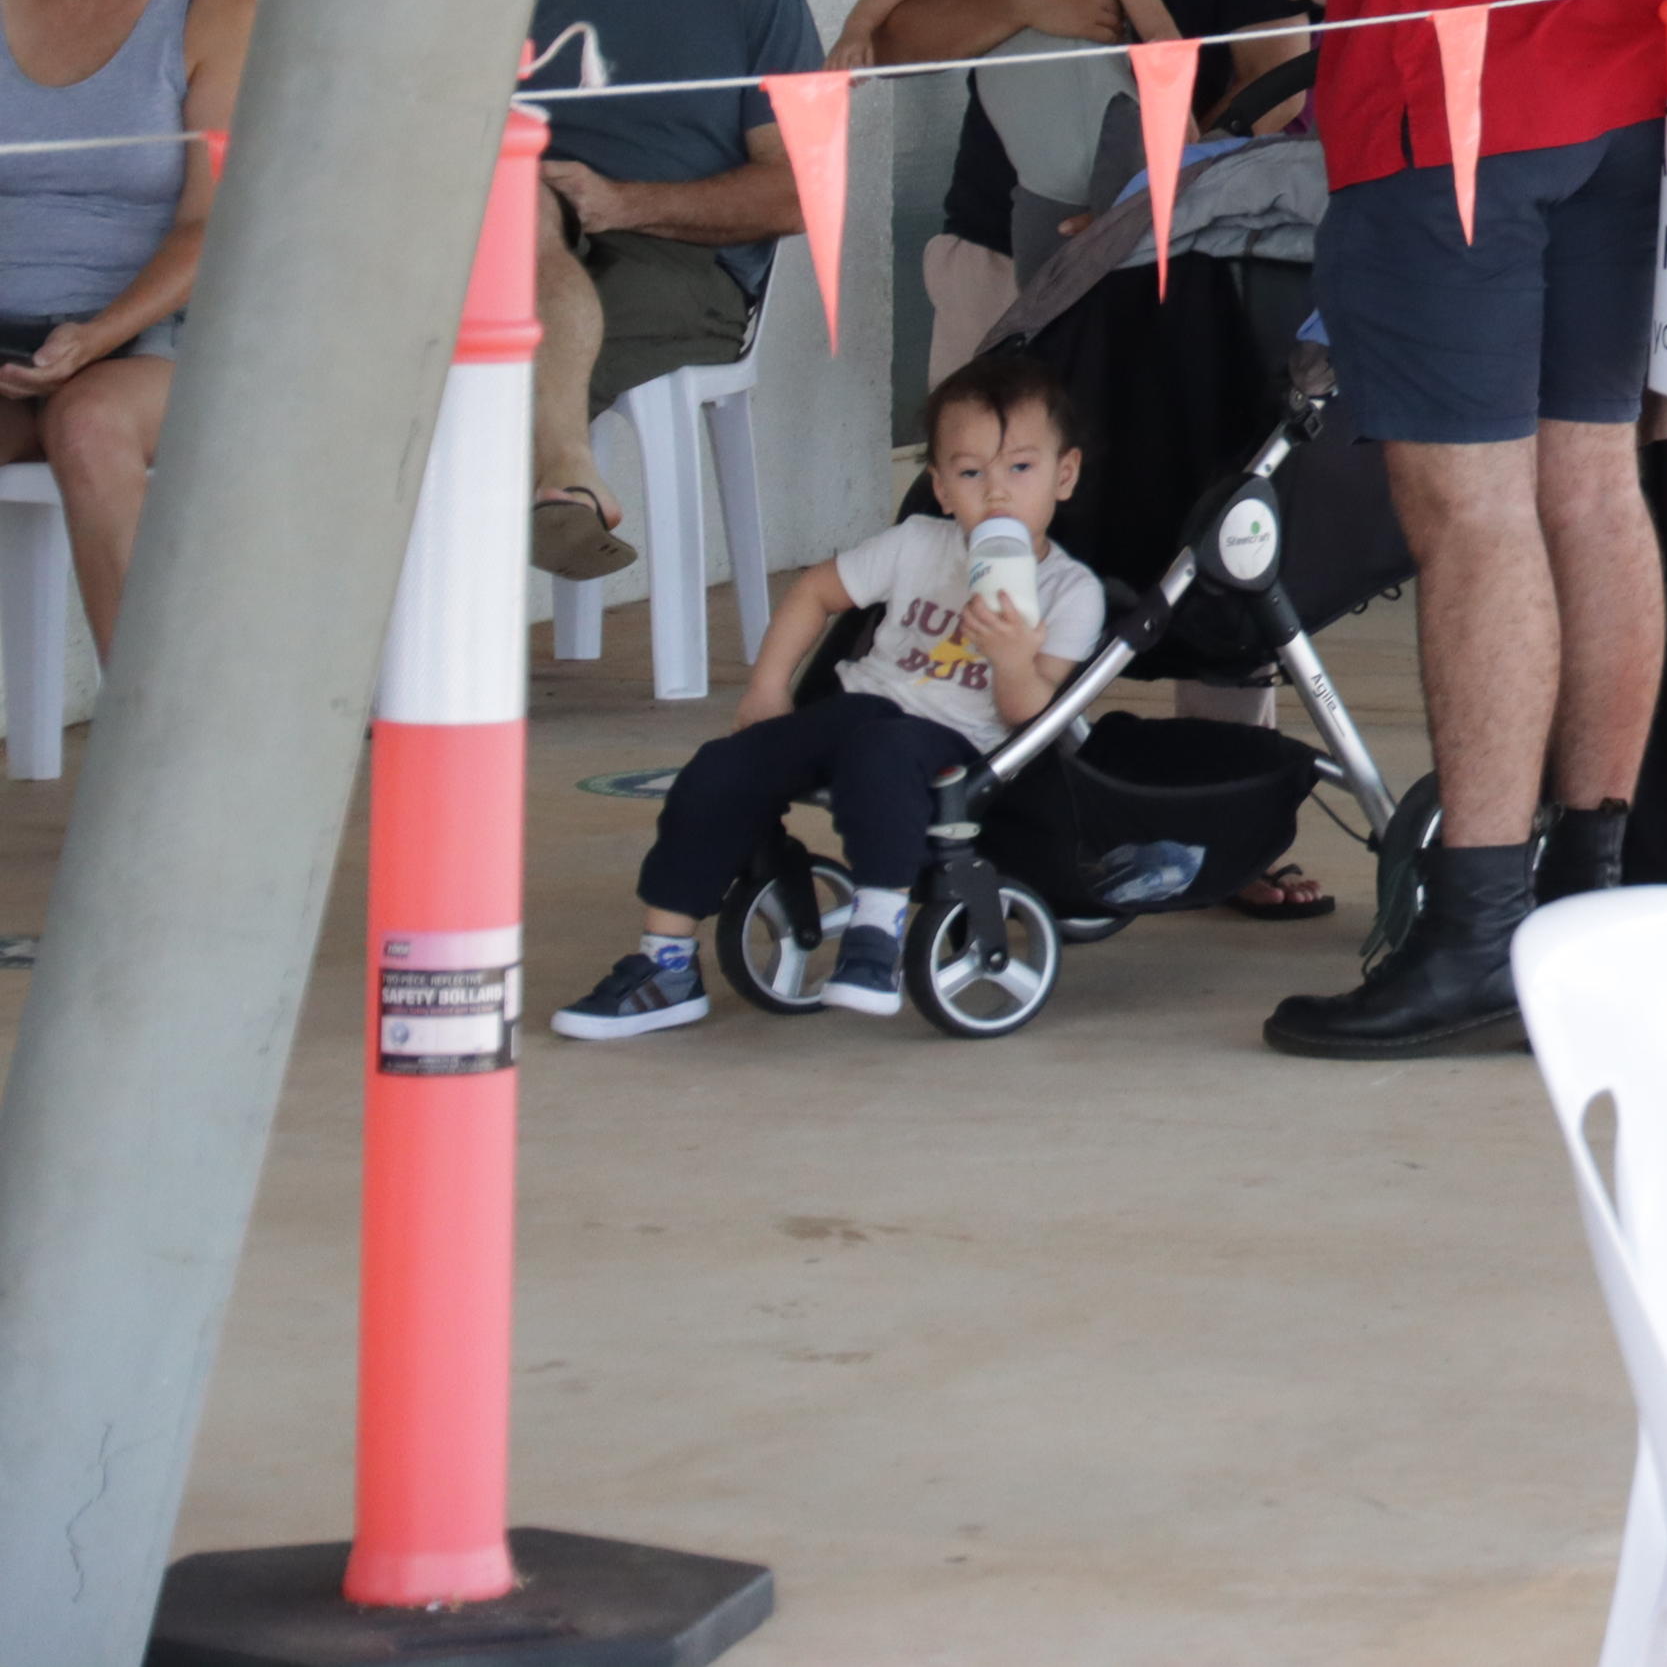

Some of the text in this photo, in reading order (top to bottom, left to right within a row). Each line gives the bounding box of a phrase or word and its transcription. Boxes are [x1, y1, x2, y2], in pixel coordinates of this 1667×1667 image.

[1310, 673, 1337, 711] Agile
[382, 985, 504, 1006] SAFETY BOLLARD
